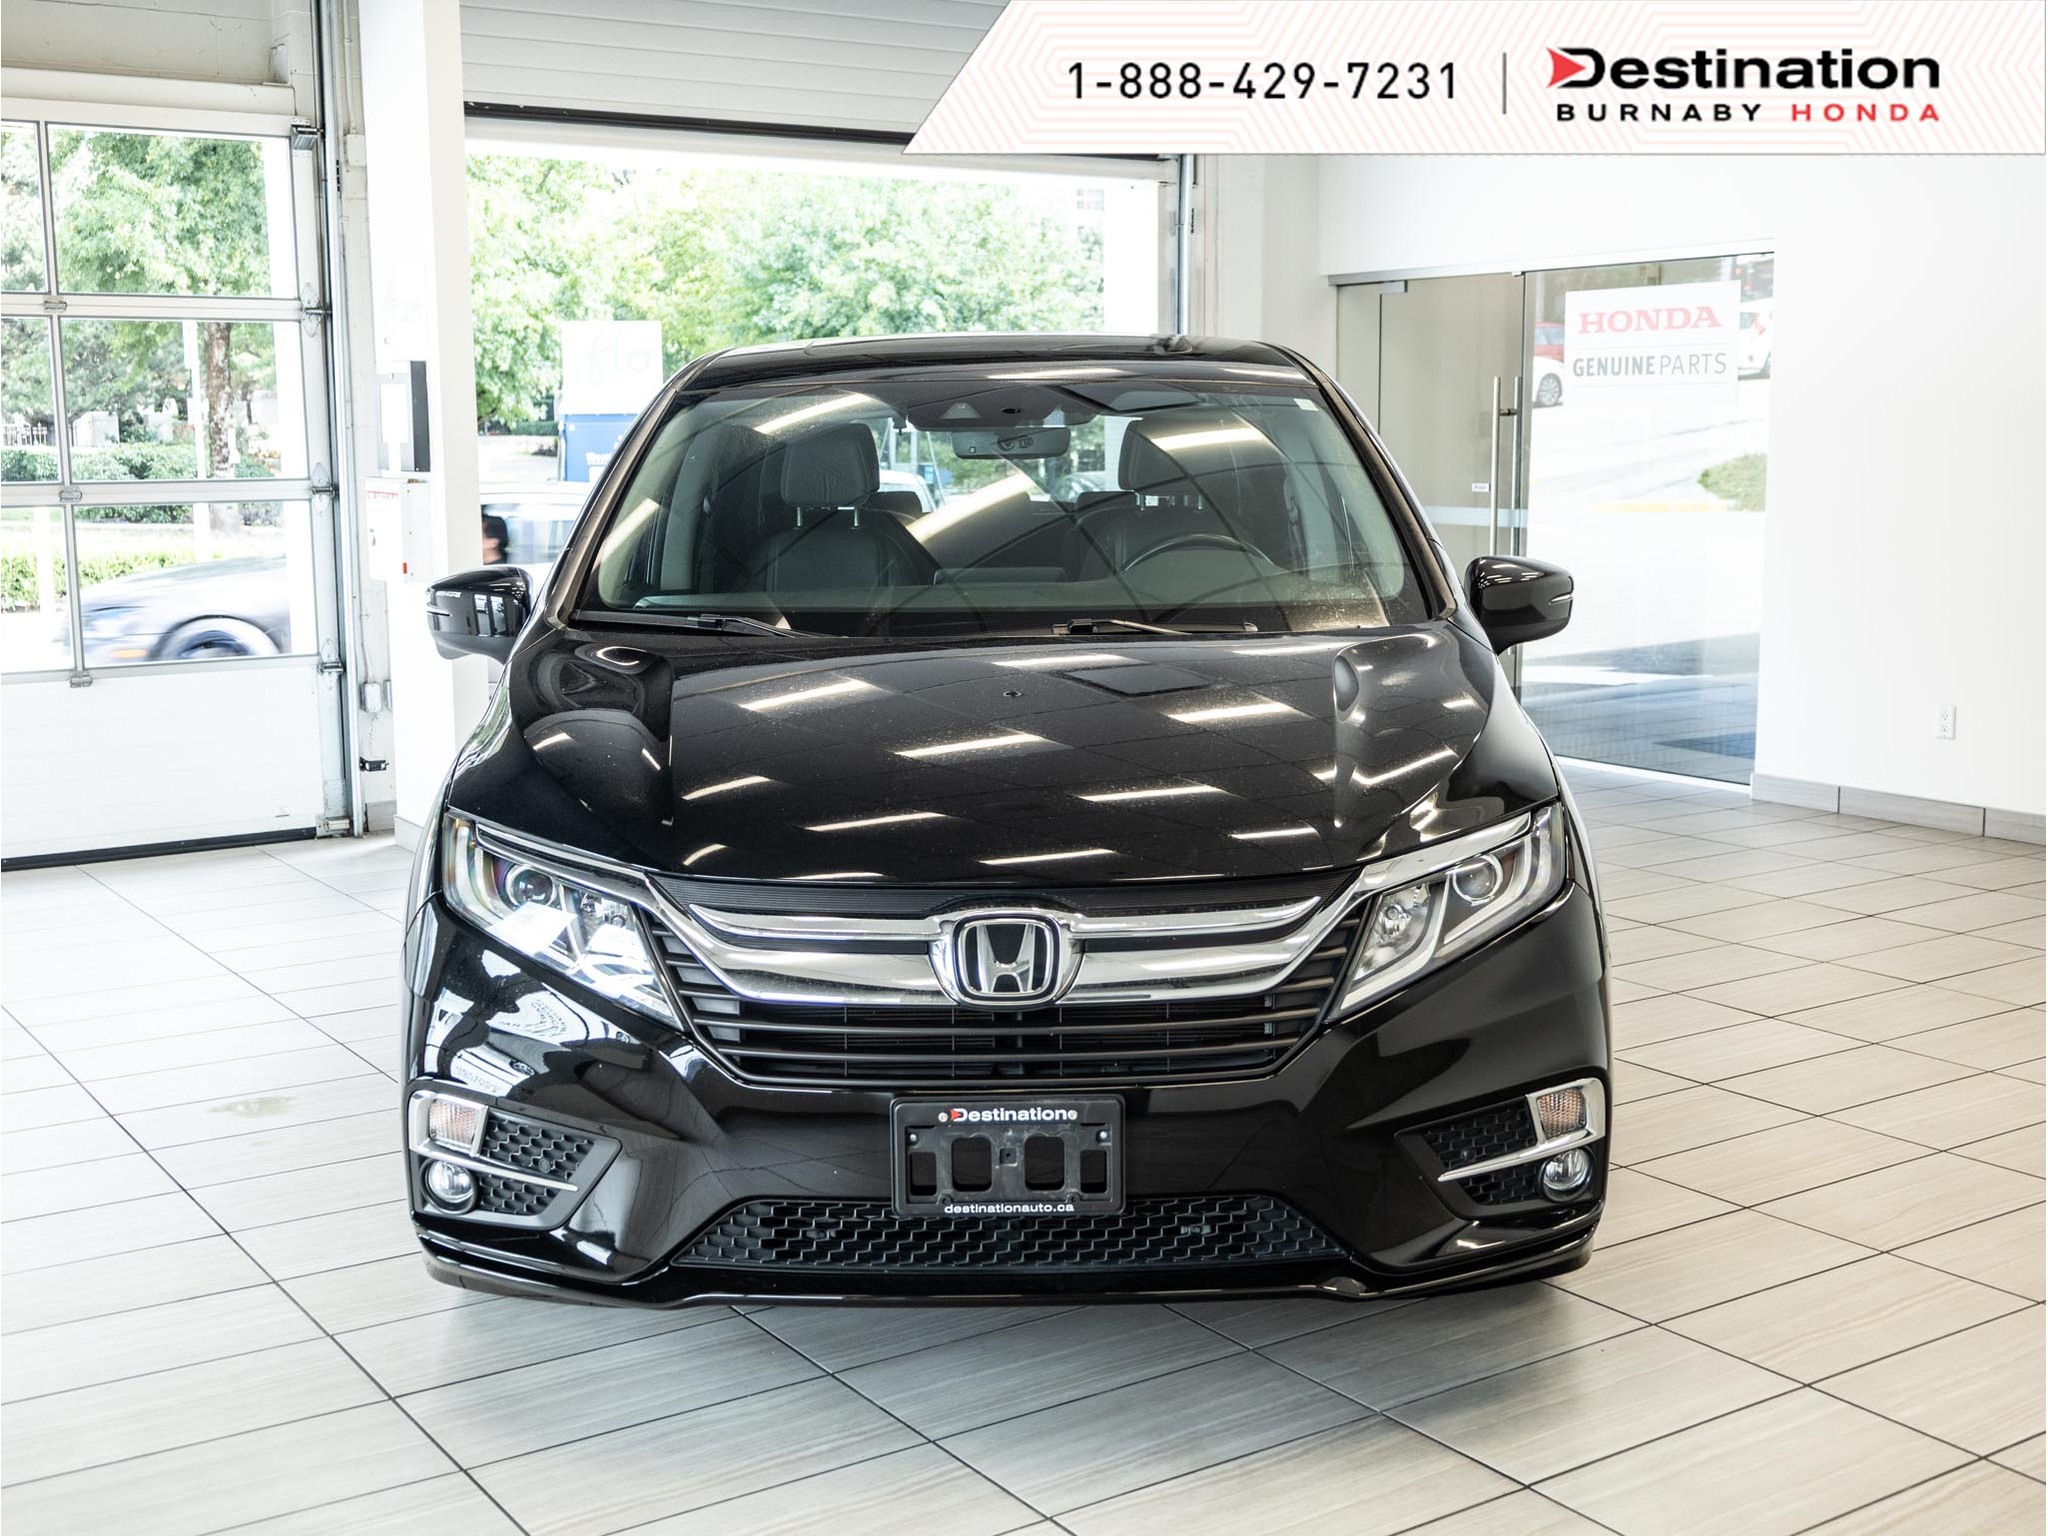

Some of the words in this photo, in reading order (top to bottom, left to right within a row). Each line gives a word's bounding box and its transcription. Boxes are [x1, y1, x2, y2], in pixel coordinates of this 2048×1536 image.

[1578, 306, 1722, 334] HONDA
[949, 1106, 1068, 1122] Destination
[943, 1202, 1075, 1215] destinationauto.ca
